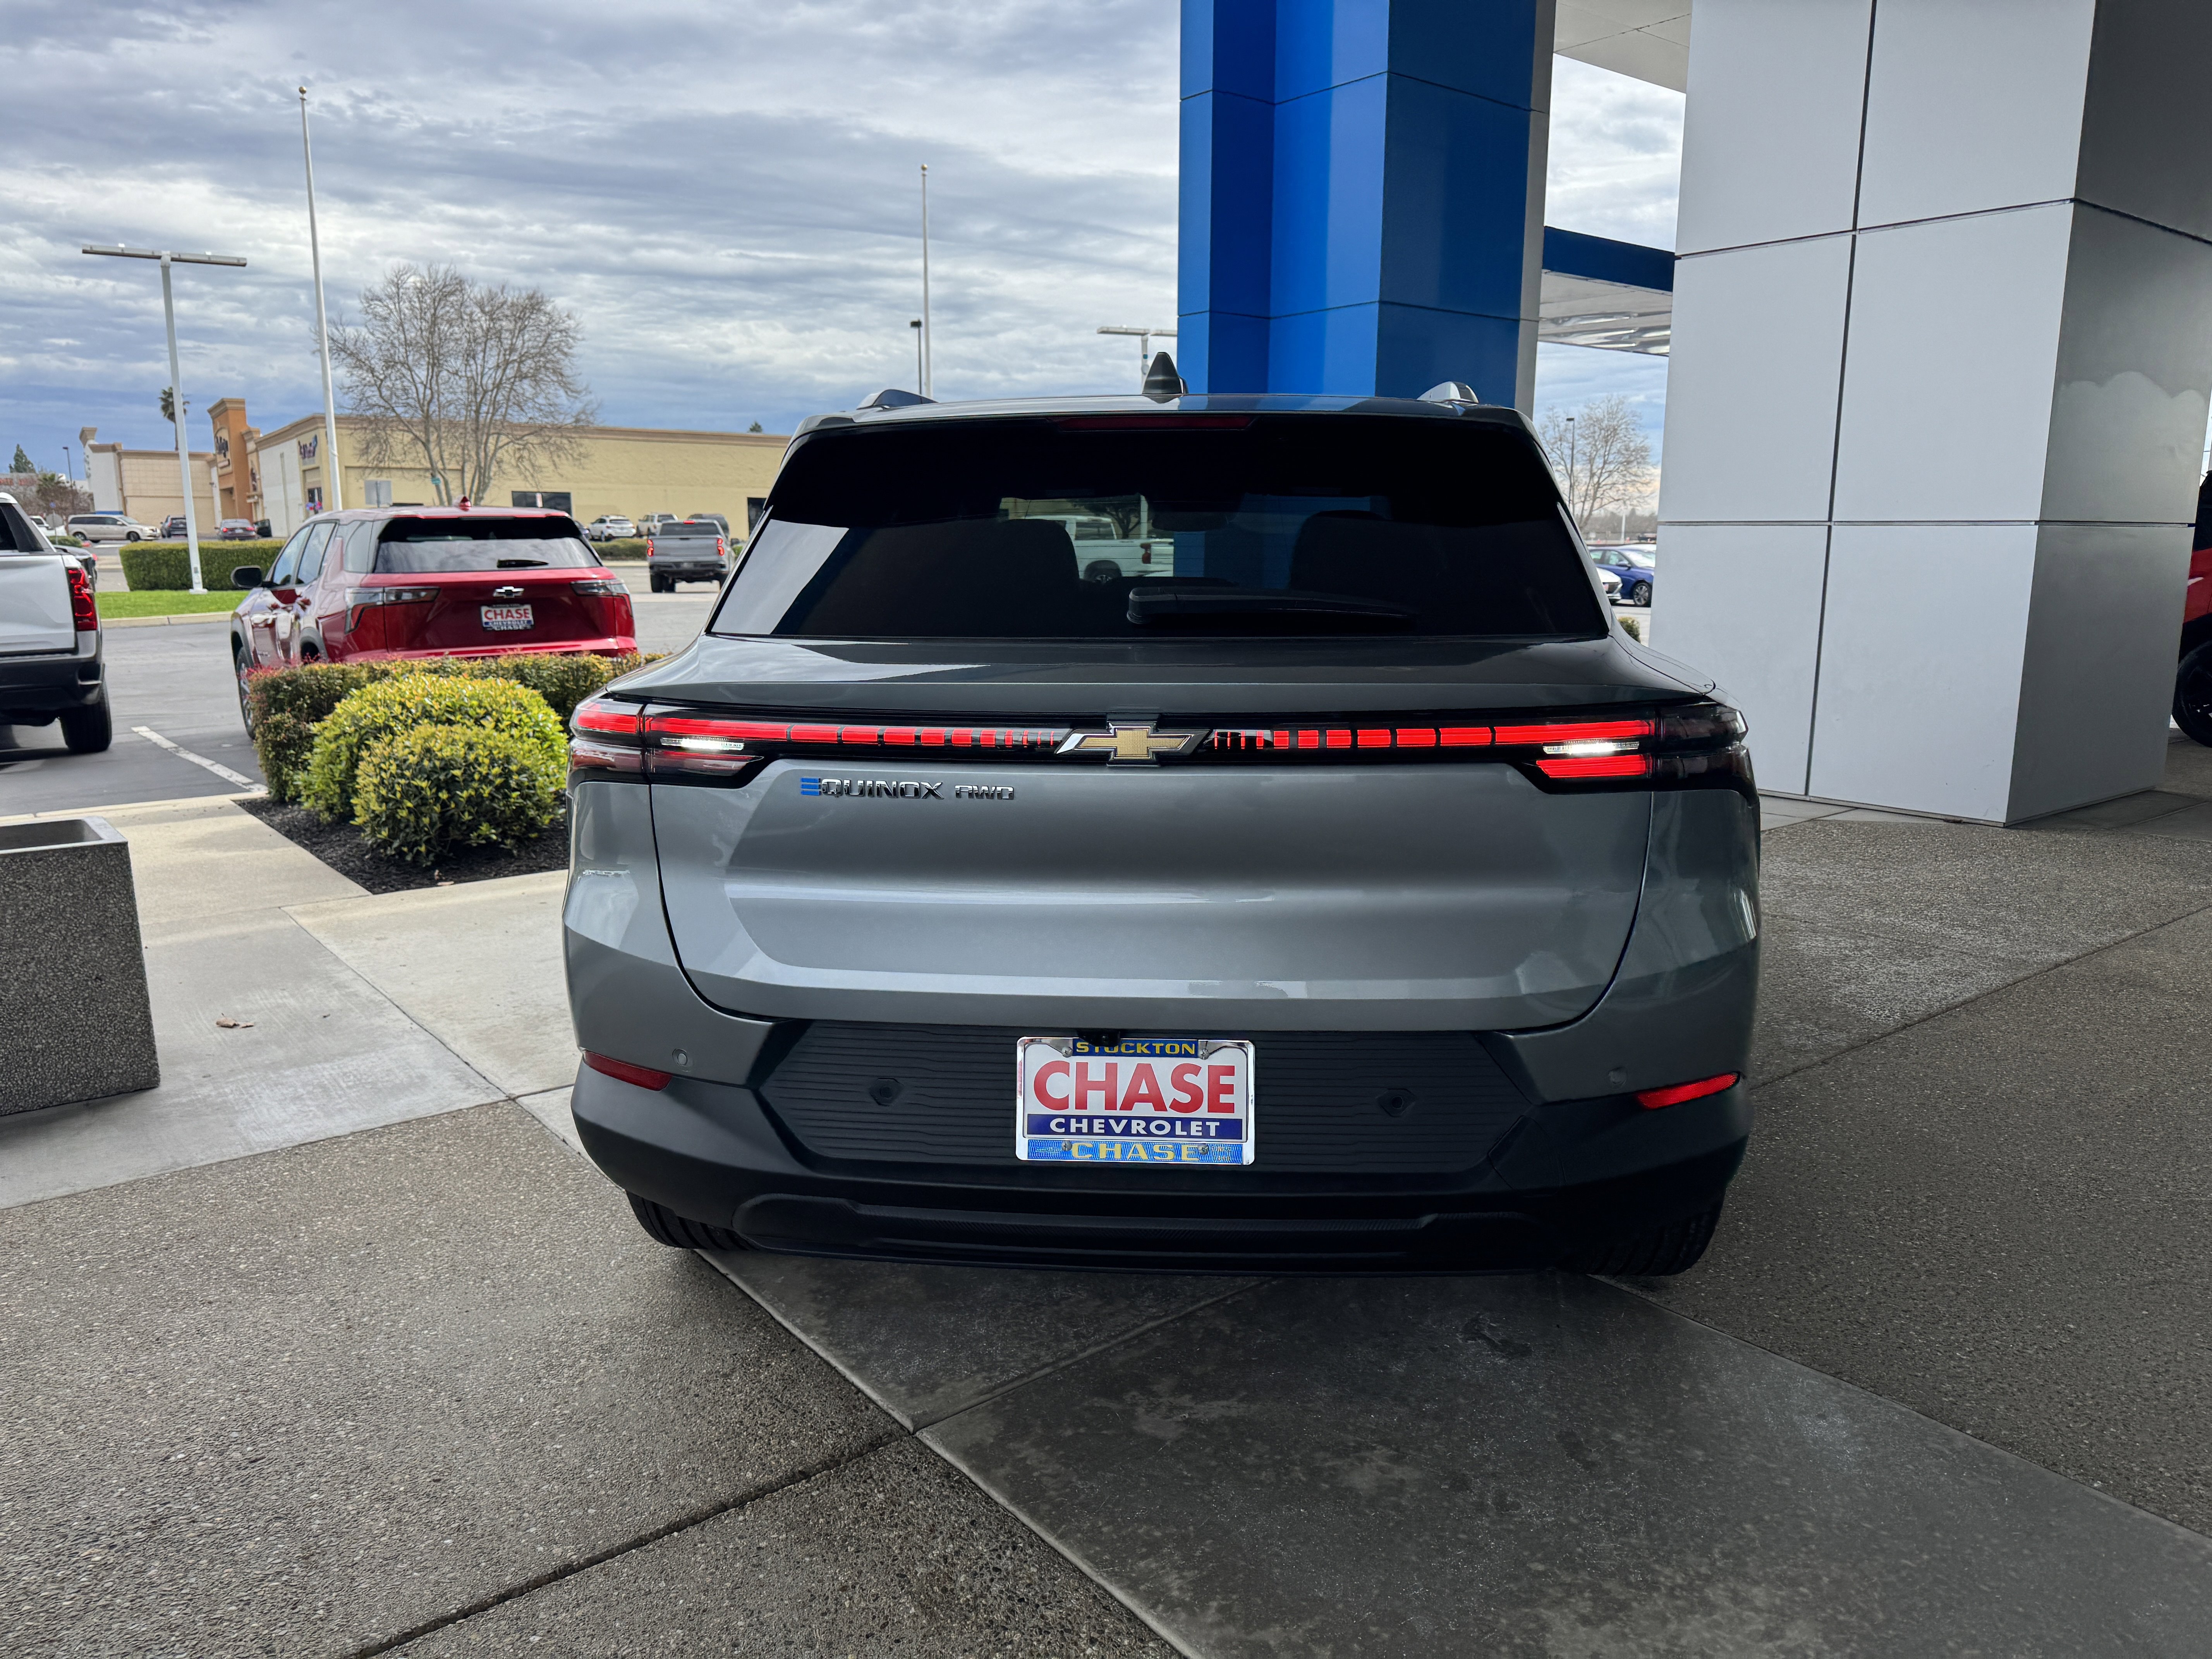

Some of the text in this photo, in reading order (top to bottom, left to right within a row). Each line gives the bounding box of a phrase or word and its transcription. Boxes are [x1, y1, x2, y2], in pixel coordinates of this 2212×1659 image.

[484, 608, 529, 620] CHASE
[800, 777, 1014, 800] EQUINOX AWD
[1034, 1061, 1235, 1113] CHASE
[1049, 1118, 1220, 1136] CHEVROLET
[1072, 1143, 1200, 1161] CHASE
